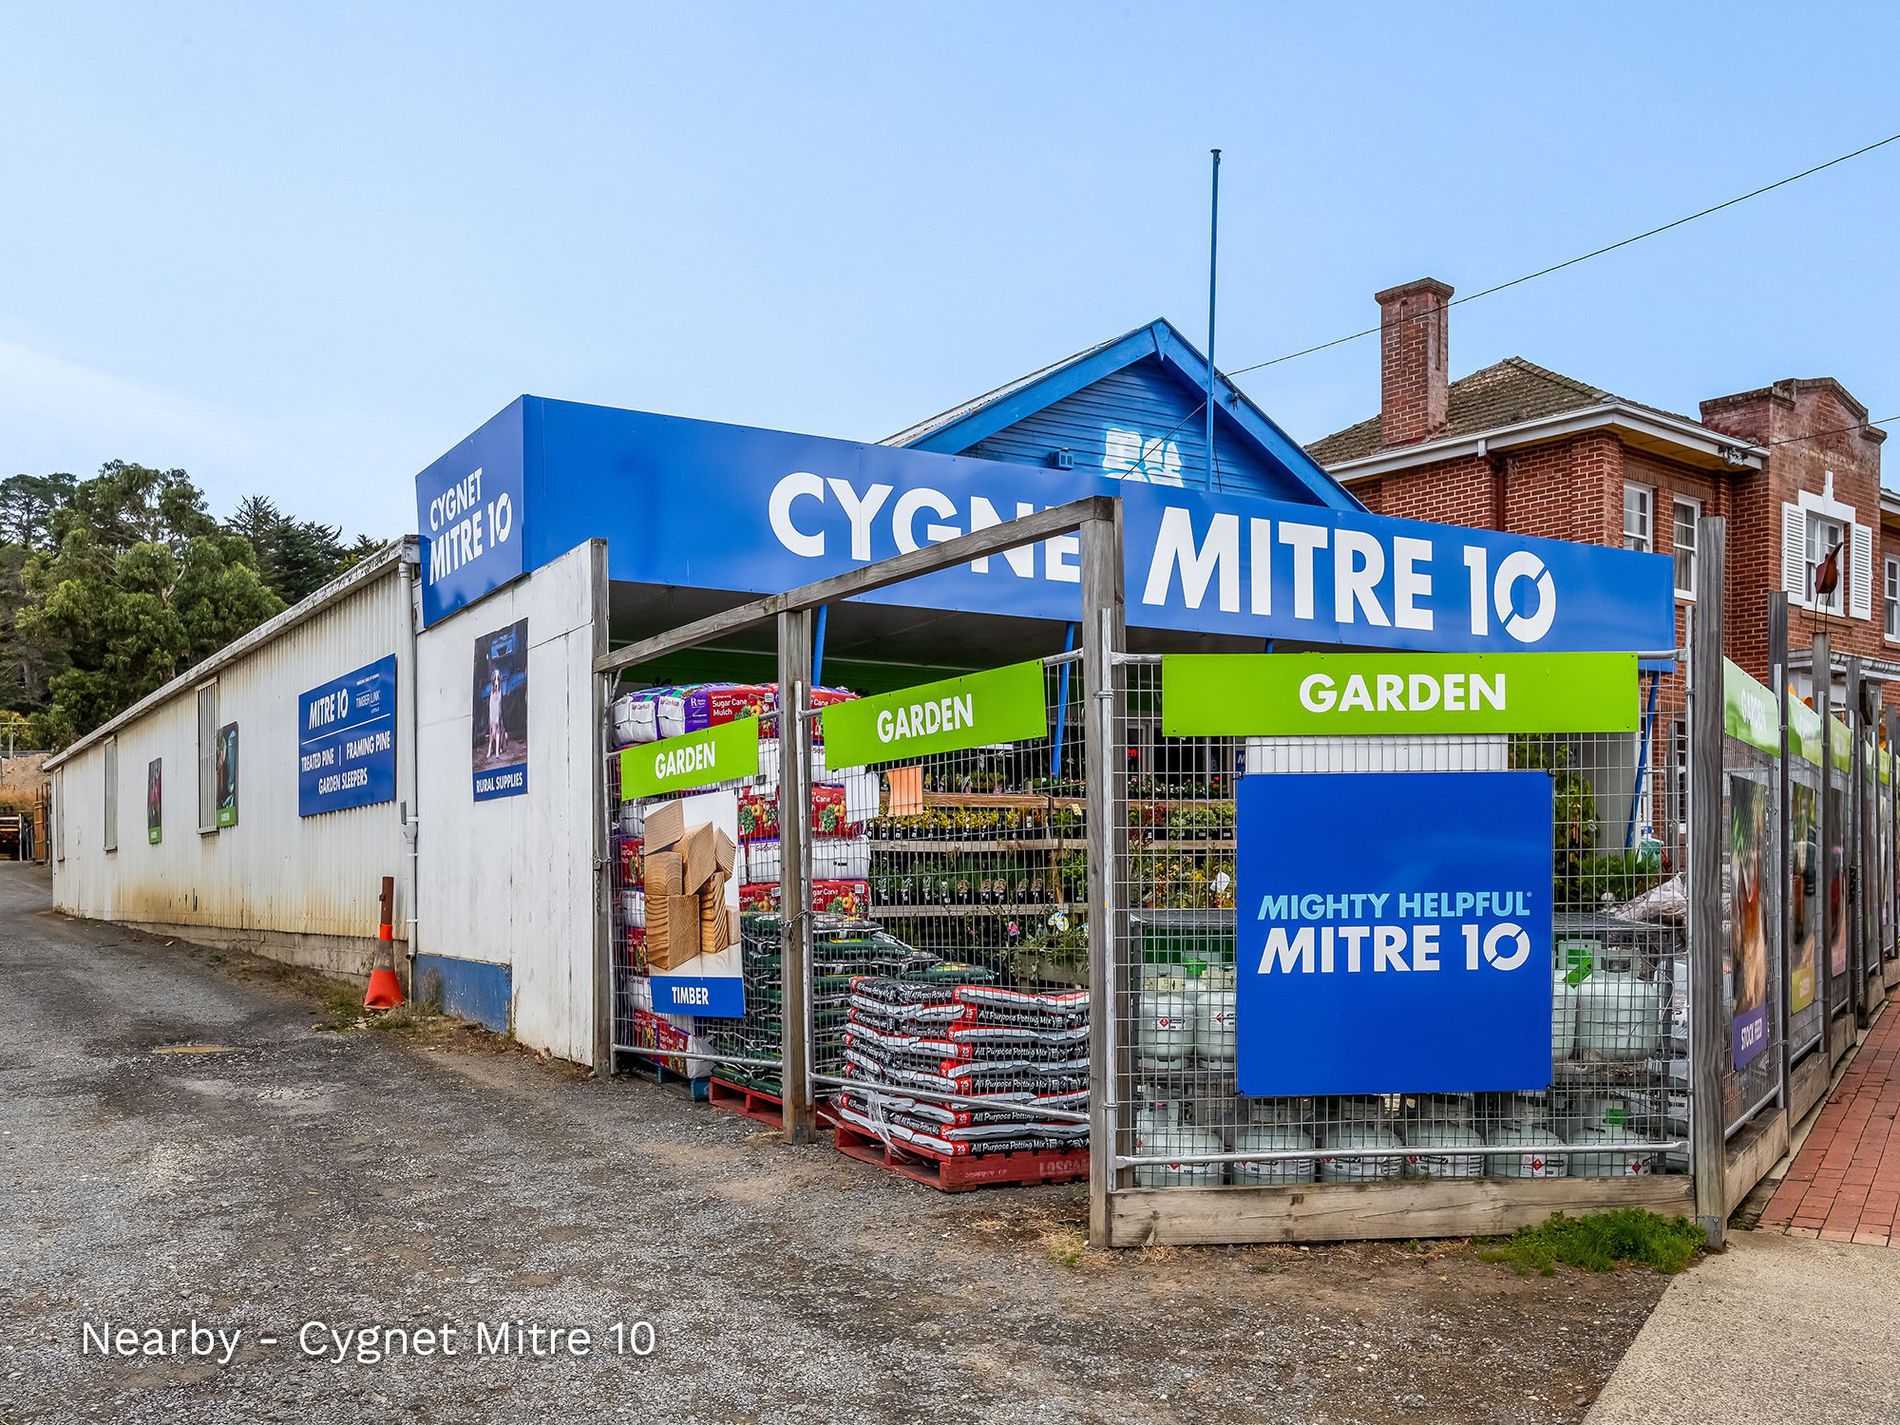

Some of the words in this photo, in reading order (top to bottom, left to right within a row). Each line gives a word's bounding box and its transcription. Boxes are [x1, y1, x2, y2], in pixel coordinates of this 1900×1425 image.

[430, 467, 482, 532] CYGNET
[430, 509, 483, 586] MITRE
[488, 492, 512, 548] 10
[768, 472, 1081, 583] CYGNE
[1142, 506, 1434, 631] MITRE
[1463, 546, 1556, 643] 10
[712, 700, 731, 708] Sugar
[731, 698, 748, 706] Cane
[1300, 673, 1506, 713] GARDEN
[308, 694, 335, 730] MITRE
[337, 688, 349, 720] 10
[713, 708, 732, 716] Mulch
[877, 693, 974, 744] GARDEN
[301, 752, 321, 773] TREATED
[322, 747, 334, 766] PINE
[346, 735, 375, 760] FRAMING
[375, 731, 391, 751] PINE
[655, 741, 716, 779] GARDEN
[318, 774, 341, 795] GARDEN
[342, 767, 368, 790] SLEEPERS
[476, 777, 495, 793] RURAL
[496, 772, 523, 788] SUPPLIES
[1257, 893, 1390, 920] MIGHTY
[1400, 891, 1531, 918] HELPFUL
[1257, 925, 1440, 974] MITRE
[1462, 922, 1531, 971] 10
[671, 986, 709, 1005] TIMBER
[989, 1011, 1016, 1022] Purpose
[1016, 1014, 1039, 1025] Potting
[986, 1047, 1012, 1057] Purpose
[1013, 1047, 1035, 1058] Potting
[985, 1080, 1012, 1090] Purpose
[973, 1113, 984, 1122] All
[984, 1112, 1012, 1122] Purpose
[1011, 1111, 1035, 1122] Potting
[972, 1143, 981, 1152] All
[982, 1142, 1009, 1153] Purpose
[1009, 1141, 1033, 1152] Potting
[1033, 1140, 1045, 1148] Mix
